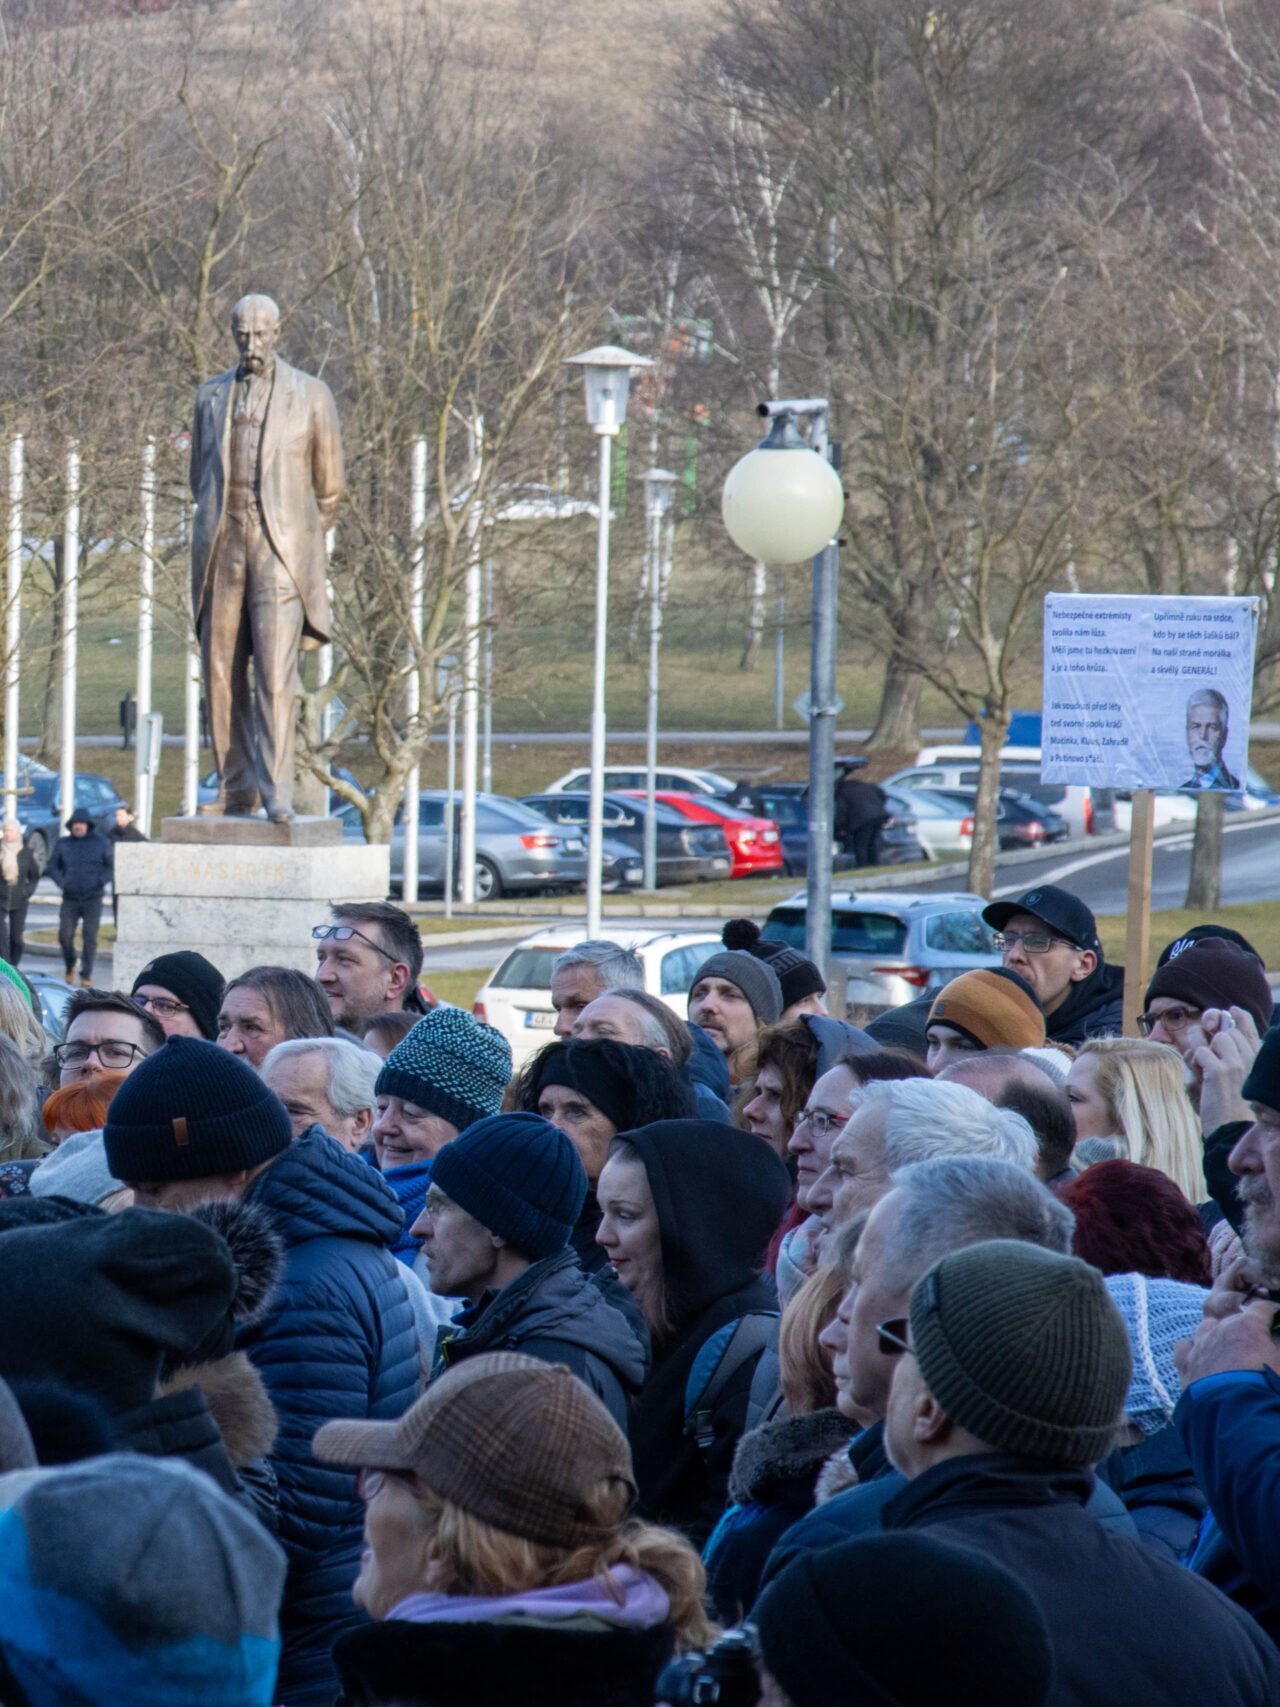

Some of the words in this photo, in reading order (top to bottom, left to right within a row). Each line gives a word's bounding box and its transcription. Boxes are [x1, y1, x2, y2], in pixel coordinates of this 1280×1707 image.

[1074, 628, 1090, 636] nám
[1153, 630, 1166, 638] kdo
[1167, 630, 1176, 640] by
[1152, 648, 1162, 656] Na
